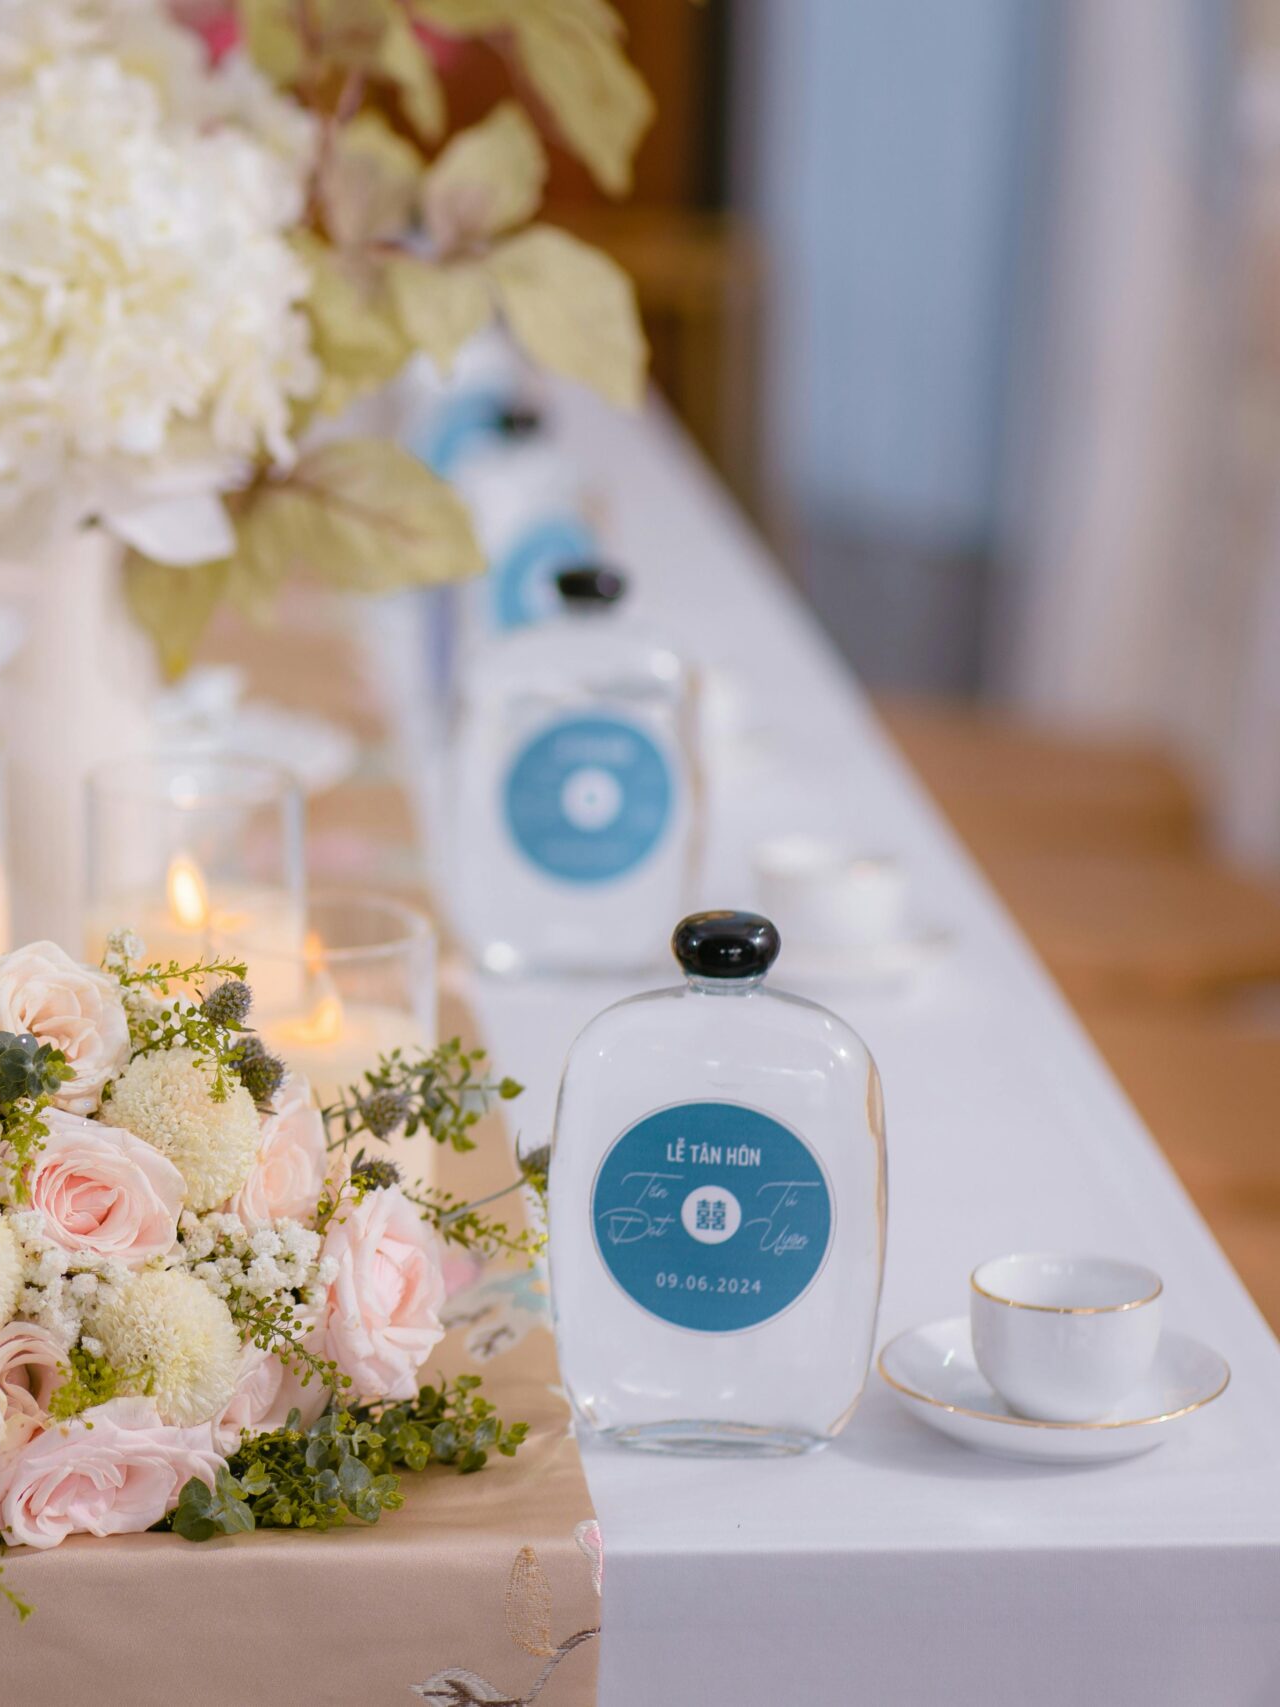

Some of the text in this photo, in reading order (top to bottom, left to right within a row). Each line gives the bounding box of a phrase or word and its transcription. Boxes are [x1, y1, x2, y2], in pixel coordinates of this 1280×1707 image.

[666, 1137, 761, 1167] LỄ TÂN HÔN
[655, 1271, 762, 1295] 09.06.2024
